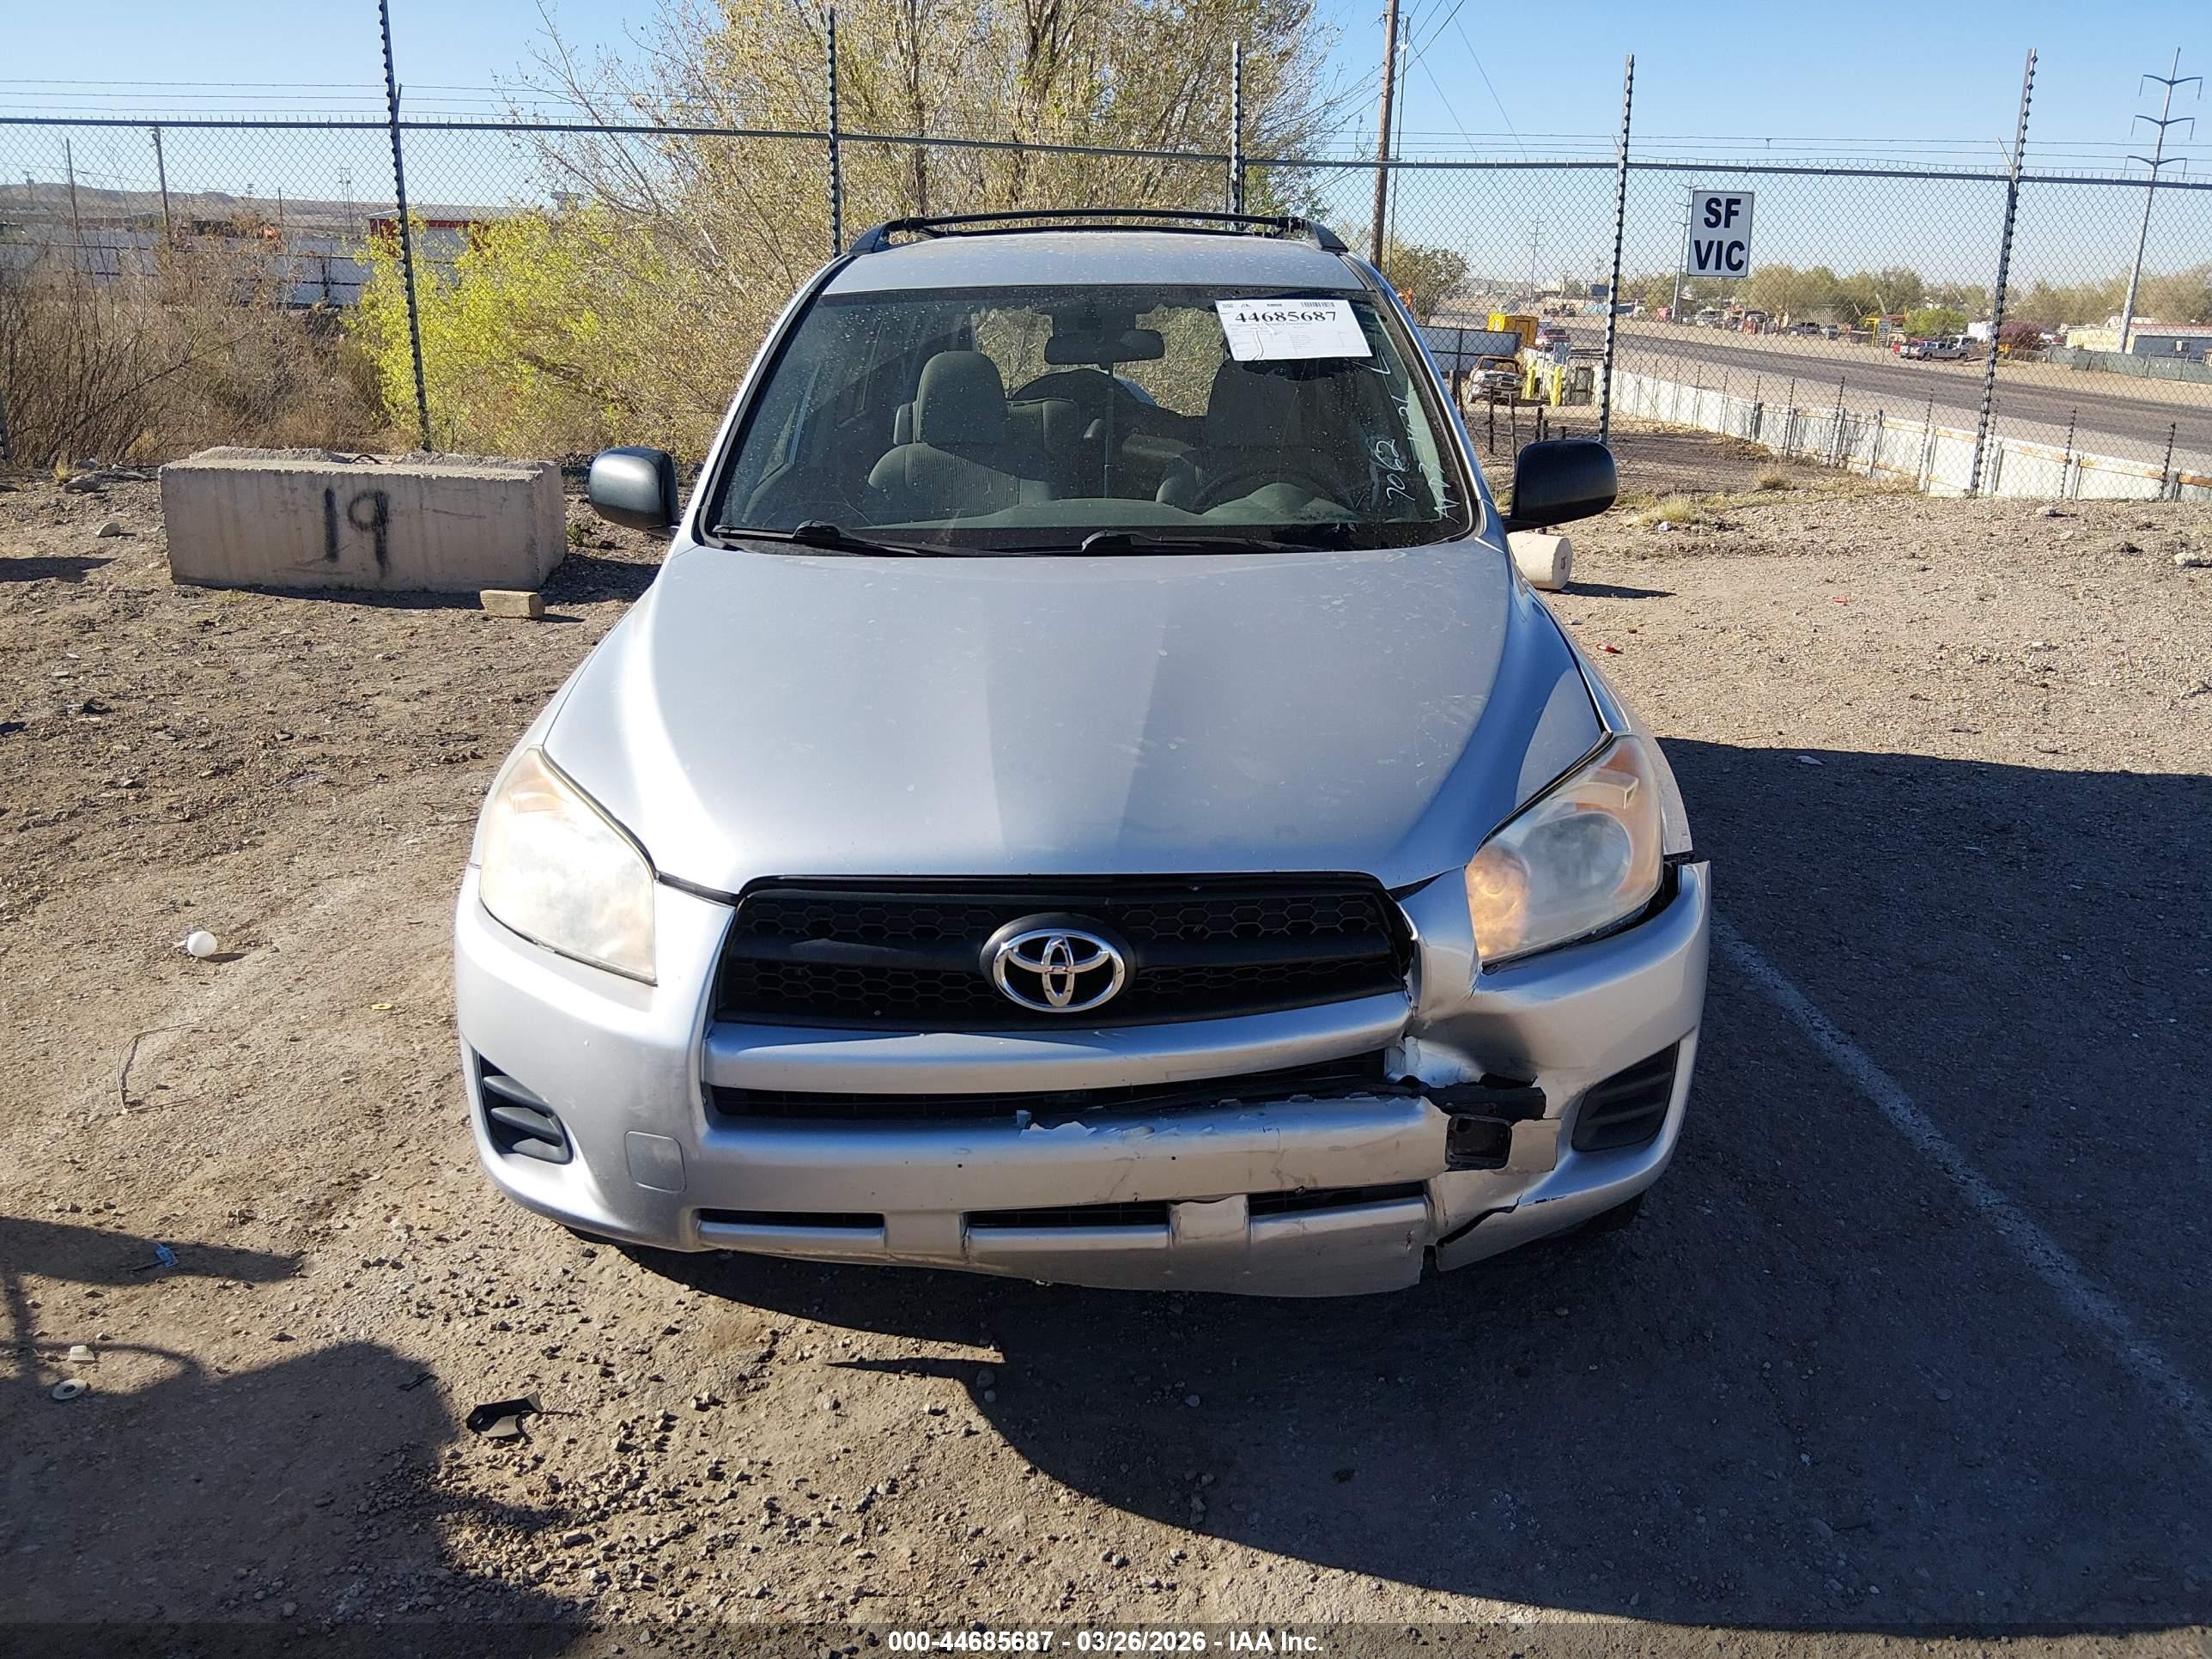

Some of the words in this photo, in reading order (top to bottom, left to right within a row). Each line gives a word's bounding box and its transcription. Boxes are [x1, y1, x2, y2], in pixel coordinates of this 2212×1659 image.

[1704, 198, 1741, 228] SF
[1694, 240, 1746, 271] VIC
[1235, 311, 1336, 323] 44685687
[1376, 439, 1416, 501] 7062
[324, 489, 389, 579] 19
